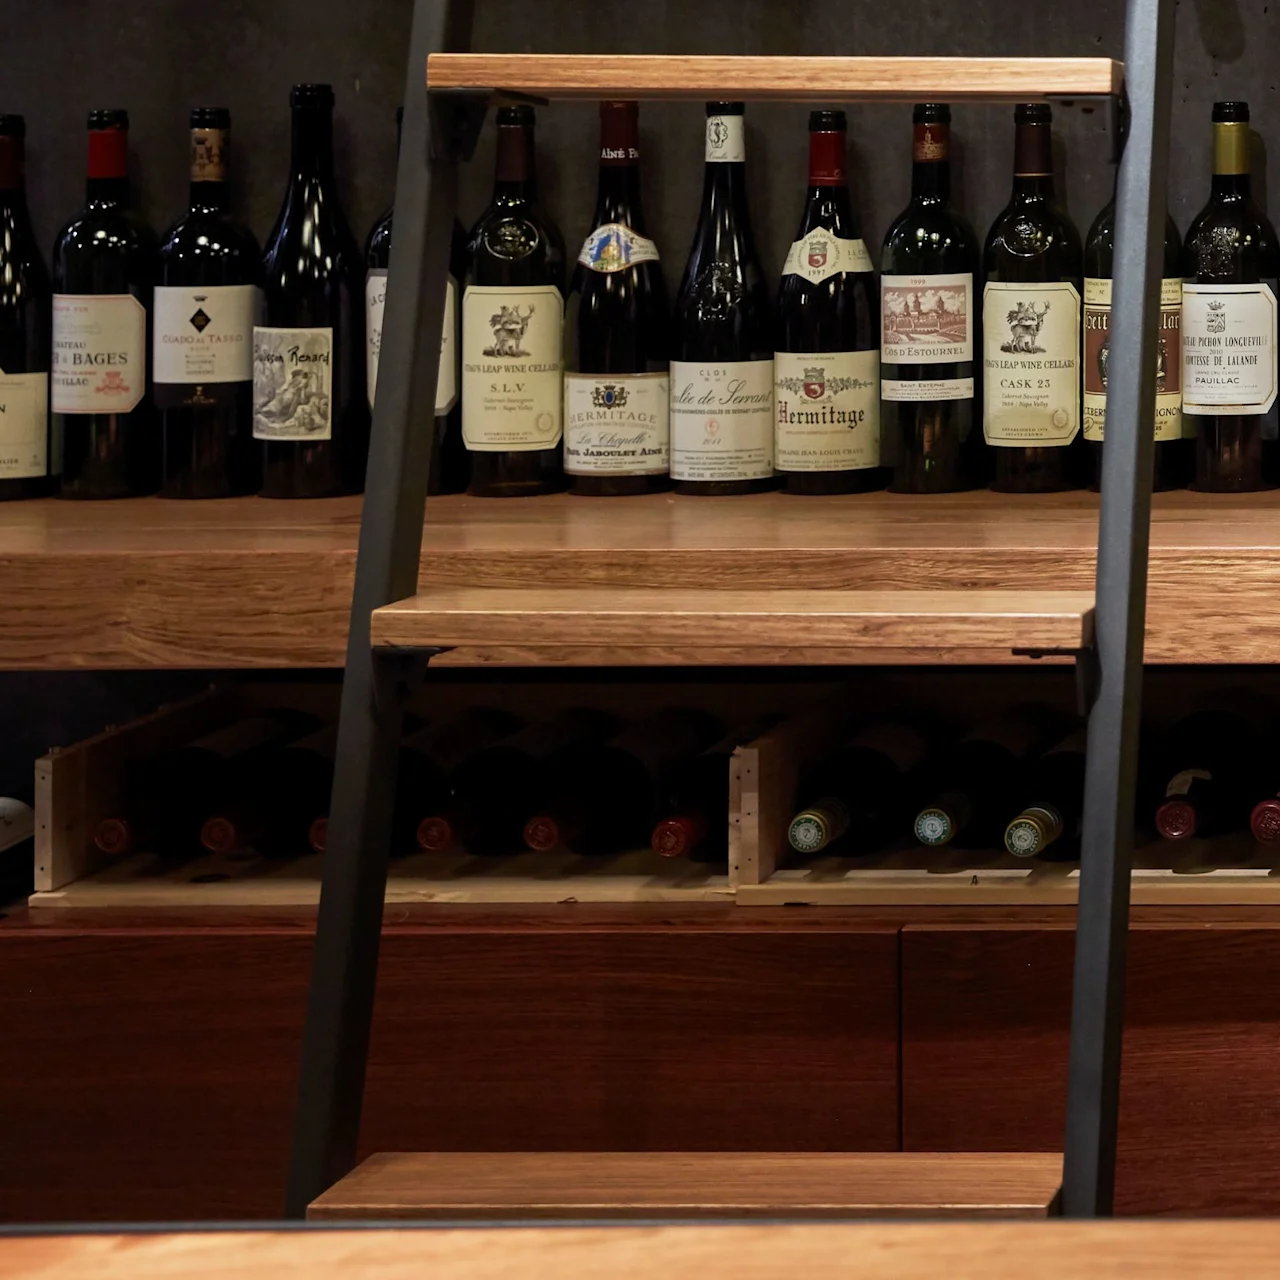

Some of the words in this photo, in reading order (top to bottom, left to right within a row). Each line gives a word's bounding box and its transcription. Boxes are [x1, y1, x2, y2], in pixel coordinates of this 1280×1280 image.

[208, 334, 244, 345] TASSO
[1198, 336, 1221, 347] PICHON
[72, 352, 129, 366] BAGES
[288, 345, 331, 366] Renard
[1214, 355, 1222, 366] DE
[1227, 355, 1258, 366] LALANDE
[482, 363, 503, 374] LEAP
[504, 363, 527, 374] WINE
[1000, 360, 1019, 370] LEAP
[1020, 360, 1042, 370] WINE
[1043, 359, 1075, 370] CELLARS
[1000, 379, 1033, 389] CASK
[1037, 379, 1051, 389] 23
[697, 389, 716, 405] de
[718, 379, 772, 405] Serrant
[570, 410, 657, 424] HERMITAGE
[778, 400, 865, 429] Hermitage
[583, 448, 637, 457] JABOULET
